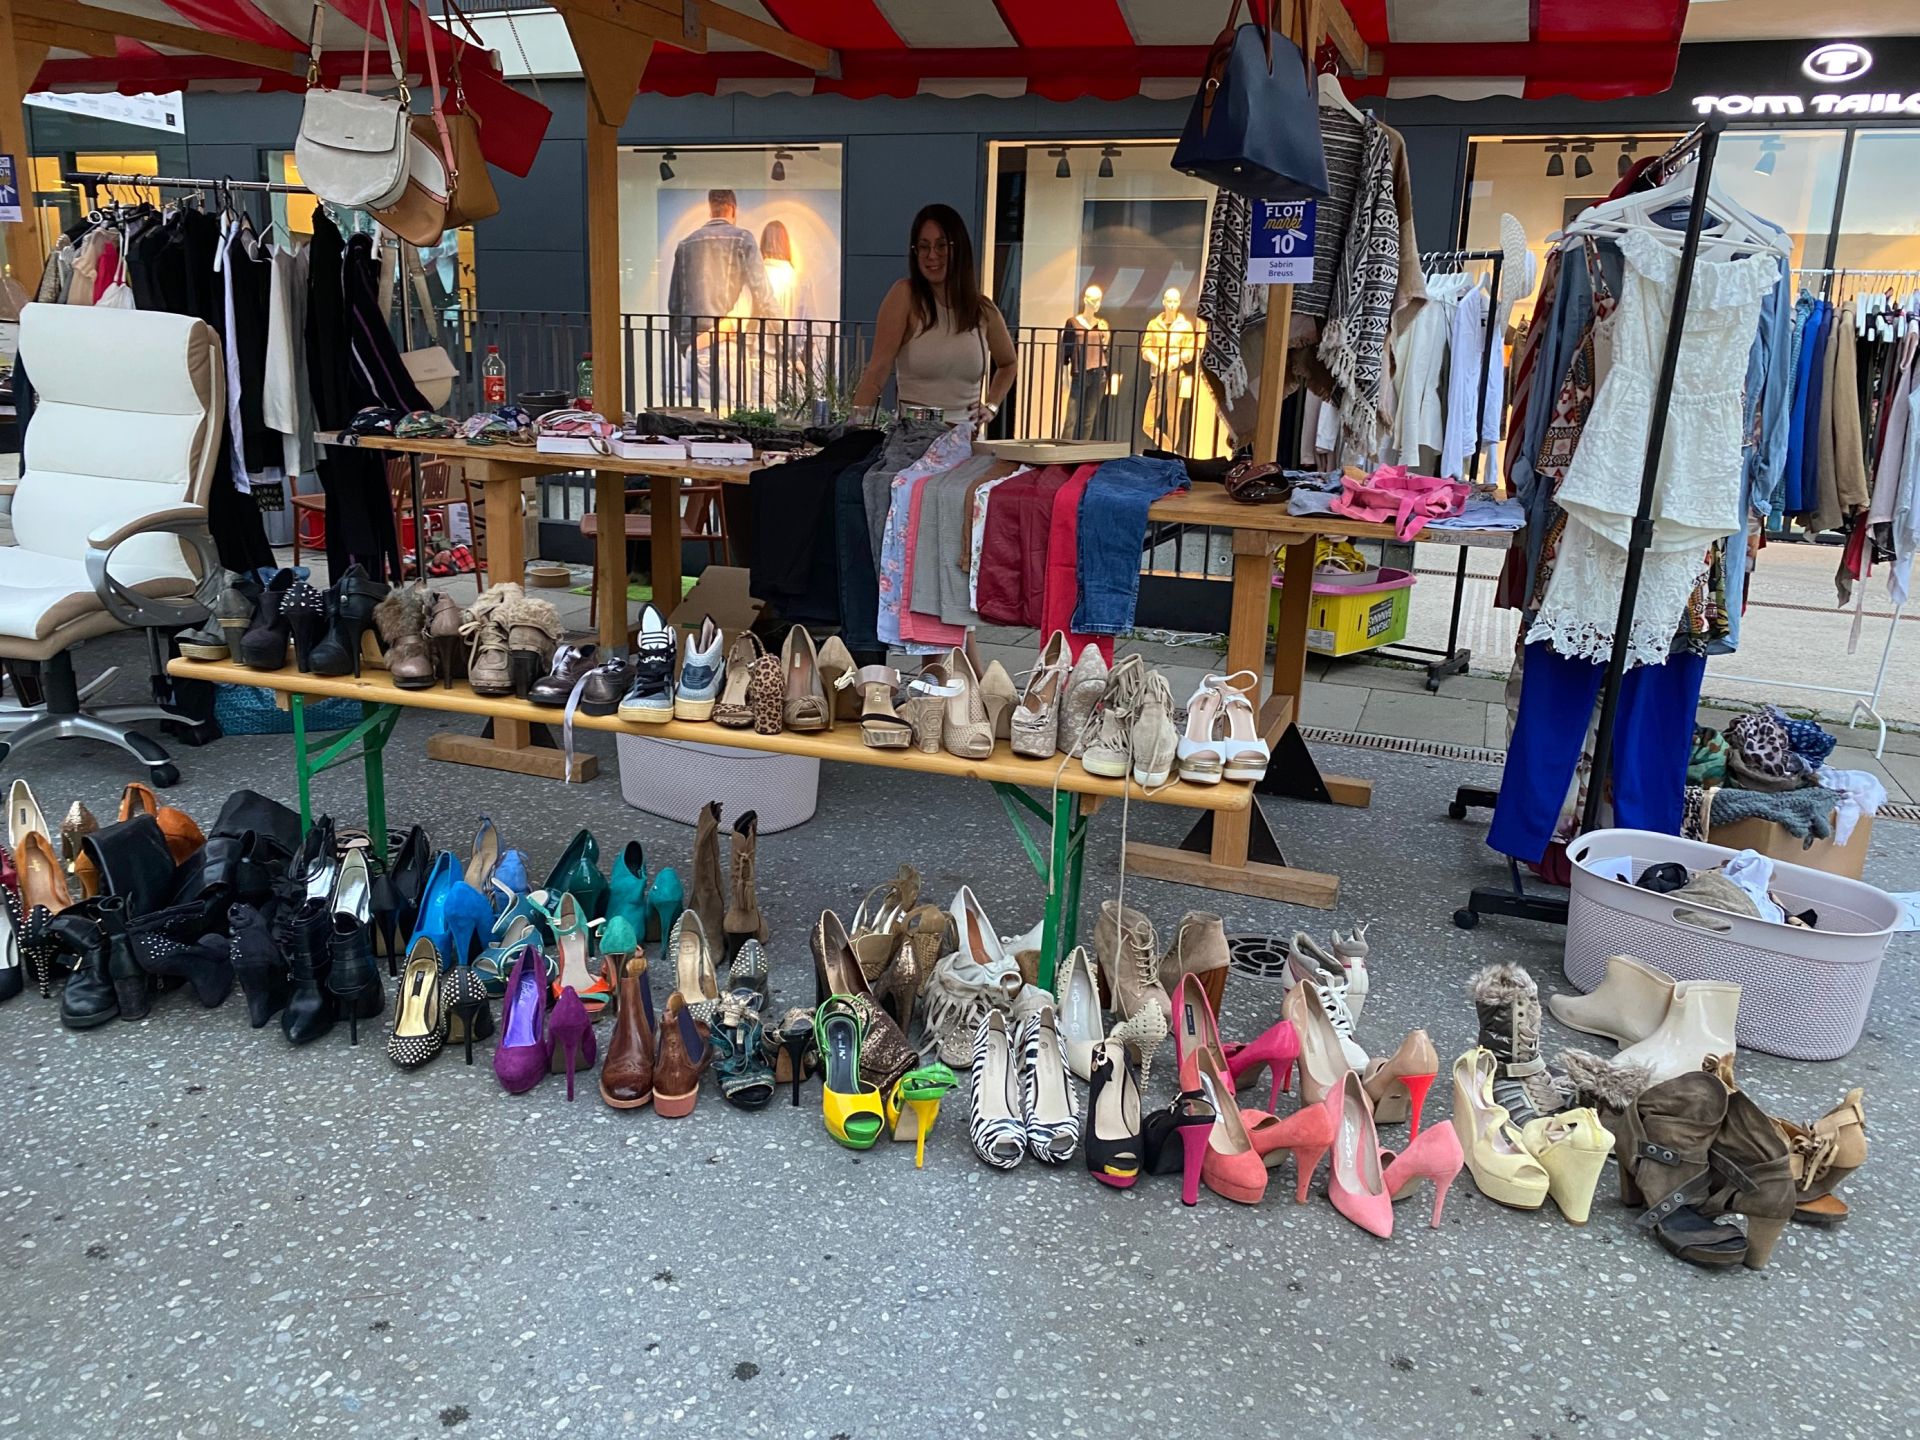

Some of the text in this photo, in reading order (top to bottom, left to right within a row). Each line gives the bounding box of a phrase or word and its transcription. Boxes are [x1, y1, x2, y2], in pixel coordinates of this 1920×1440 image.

[1692, 94, 1804, 115] TOM
[1266, 206, 1304, 217] FLOH
[1263, 215, 1303, 230] markt
[1271, 234, 1295, 254] 10
